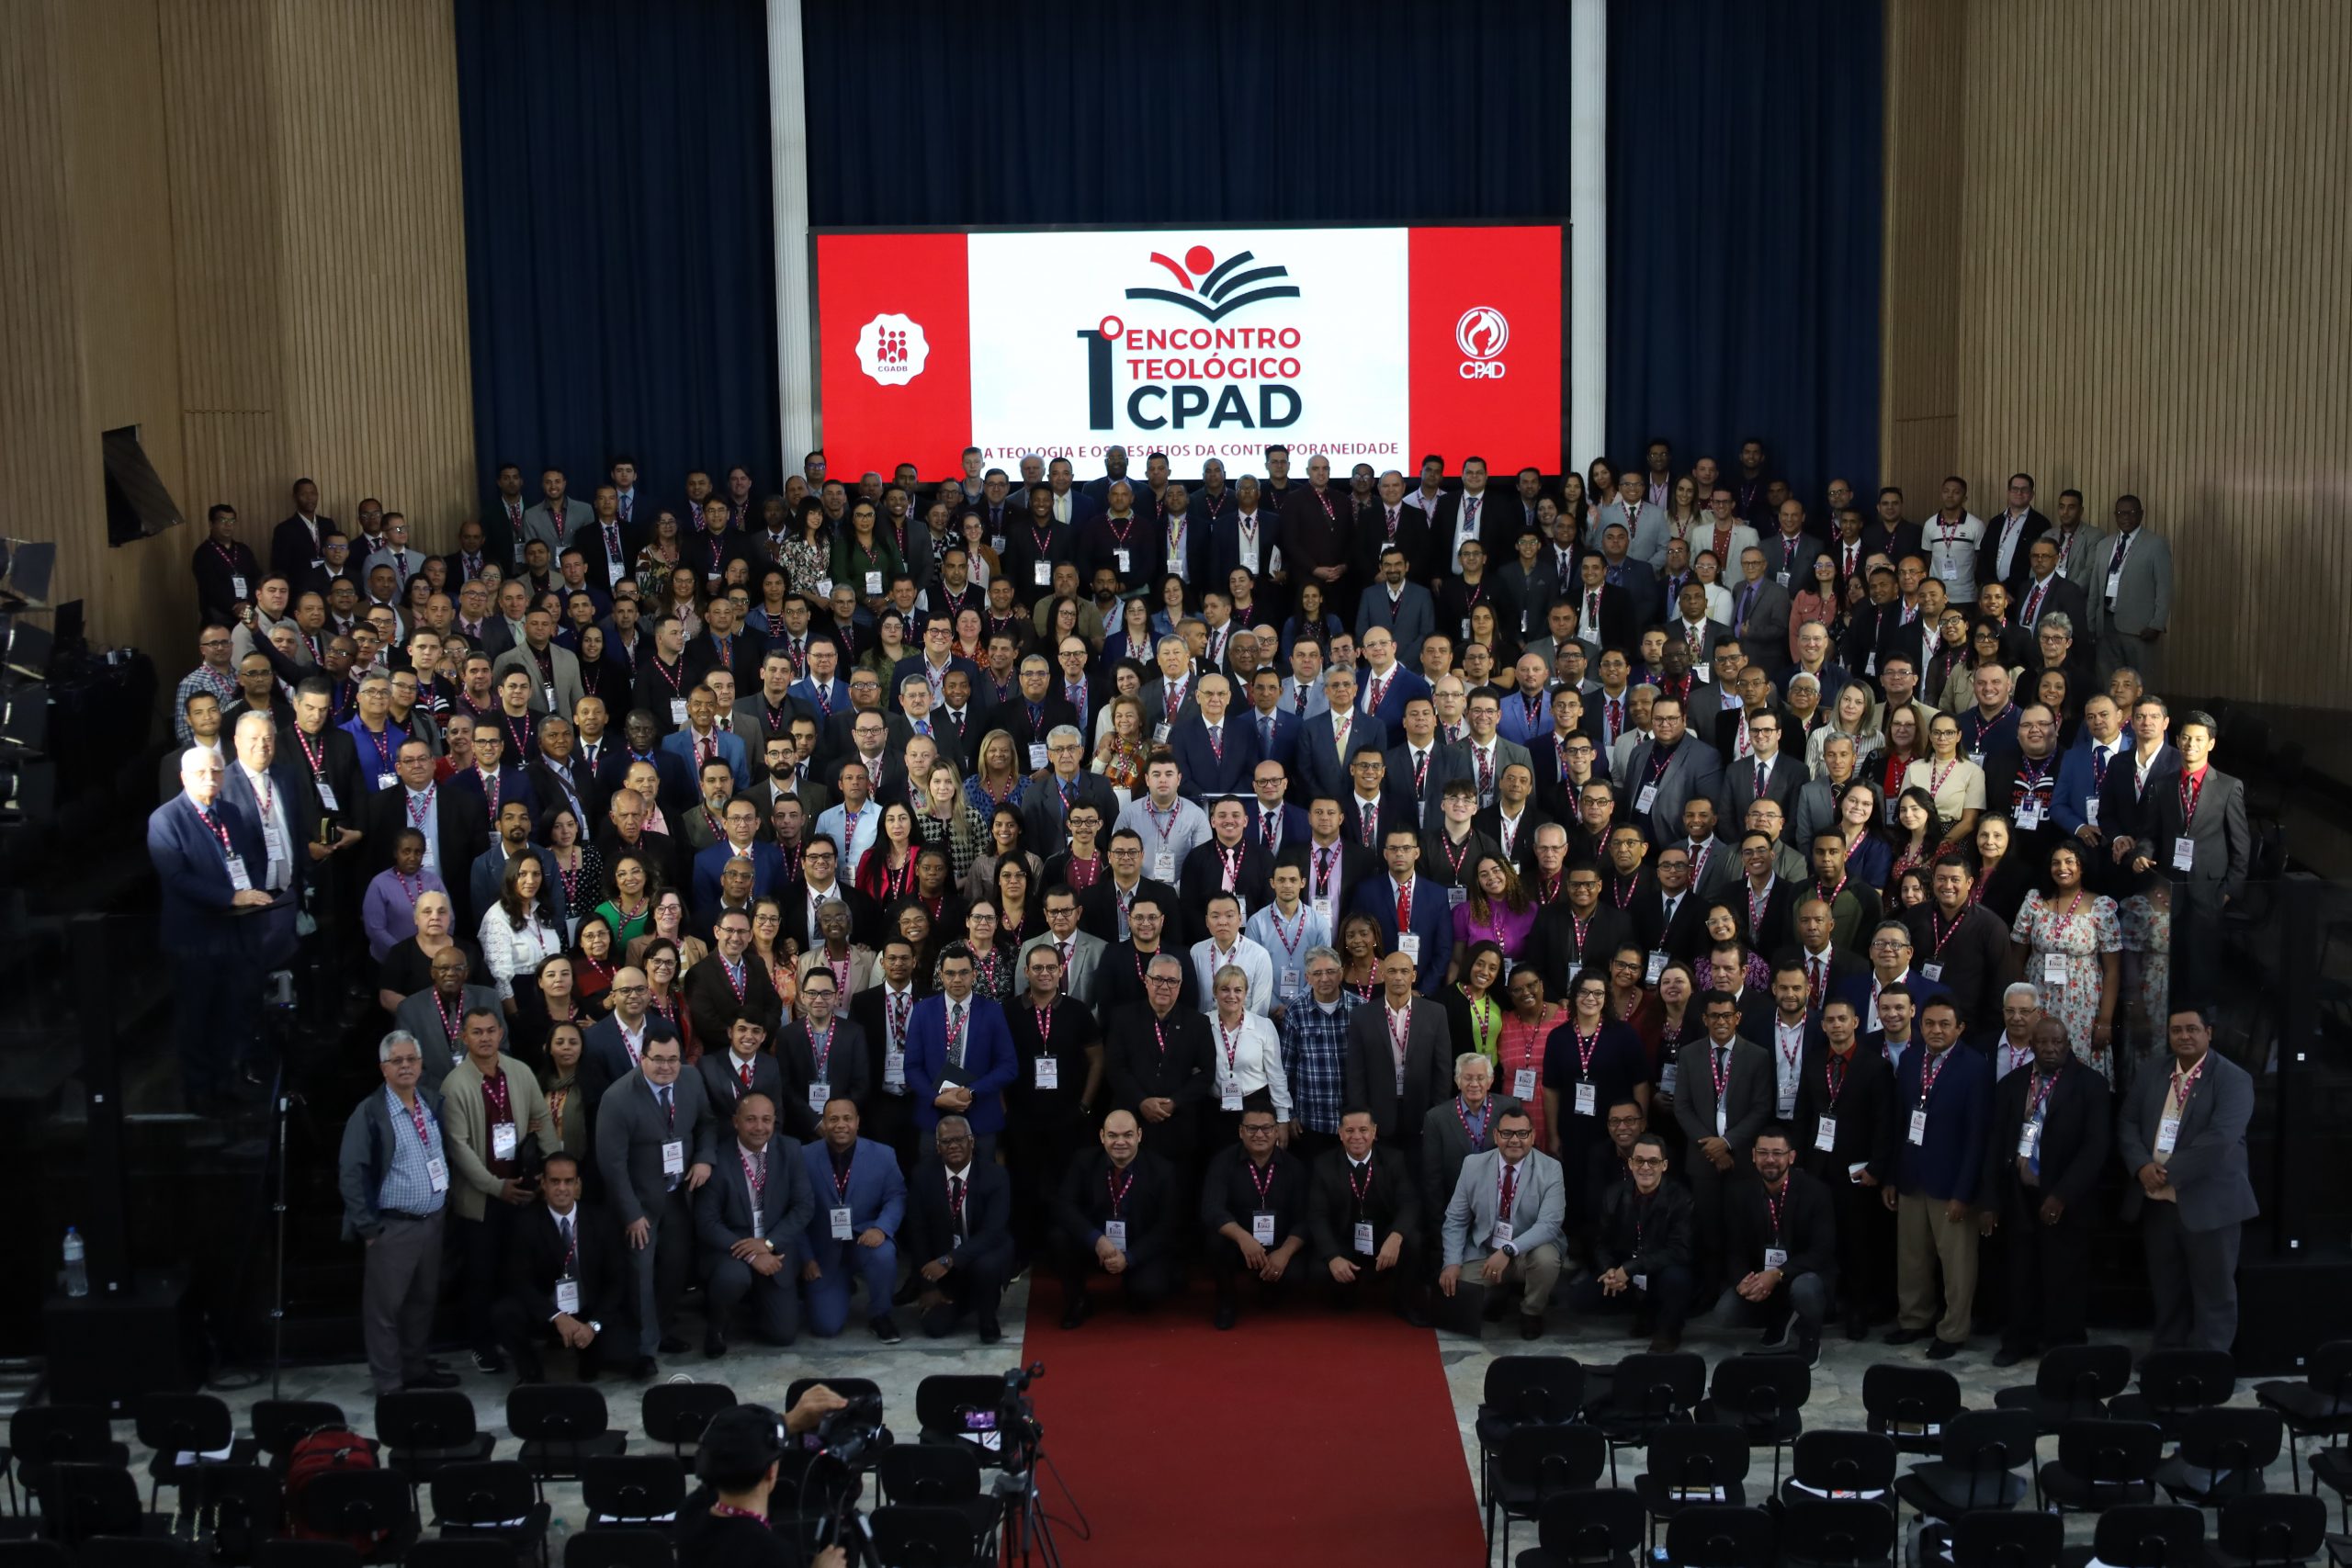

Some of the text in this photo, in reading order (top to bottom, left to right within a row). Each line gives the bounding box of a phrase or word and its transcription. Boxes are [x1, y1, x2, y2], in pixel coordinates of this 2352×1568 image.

[1126, 328, 1301, 350] ENCONTRO
[1126, 353, 1301, 379] TEOLÓGICO
[1459, 361, 1506, 379] CPAD
[1126, 384, 1302, 431] CPAD
[984, 447, 993, 458] A
[1080, 446, 1086, 457] E
[1195, 445, 1216, 457] DA
